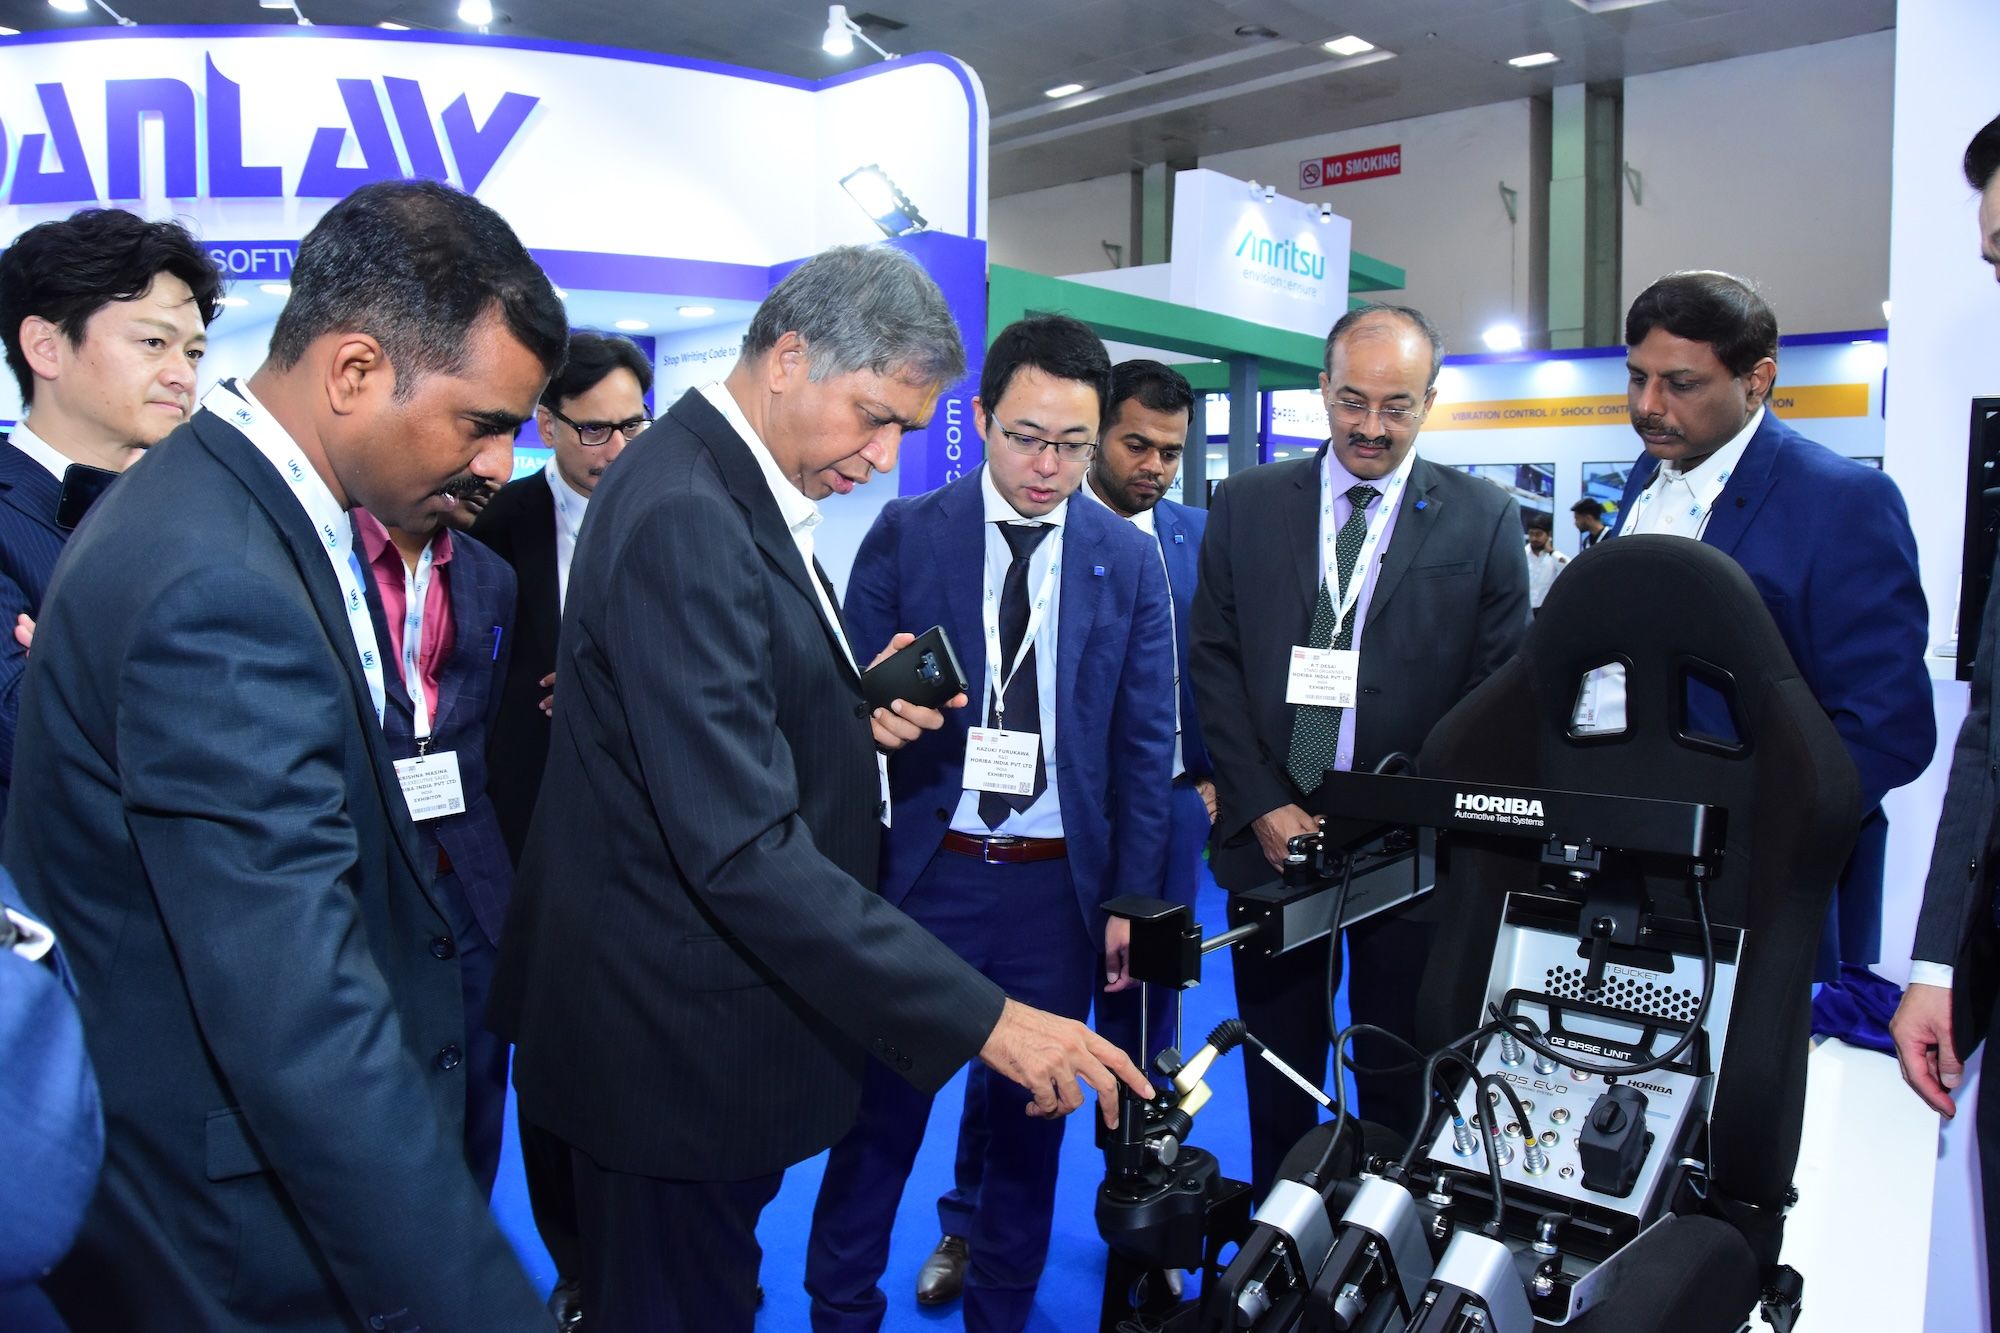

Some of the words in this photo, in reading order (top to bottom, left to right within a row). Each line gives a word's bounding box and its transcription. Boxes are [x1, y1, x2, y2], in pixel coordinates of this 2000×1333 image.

[1326, 162, 1343, 178] NO
[1346, 152, 1399, 175] SMOKING
[1235, 229, 1325, 280] Anritsu
[663, 355, 680, 366] Stop
[681, 350, 707, 364] Writing
[708, 347, 727, 359] Code
[1451, 410, 1500, 421] VIBRATION
[1503, 408, 1547, 418] CONTROL
[1560, 406, 1594, 417] SHOCK
[998, 748, 1030, 756] FURUKAWA
[425, 768, 448, 776] MASINA
[987, 771, 1015, 779] EXHIBITOR
[413, 794, 442, 803] EXHIBITOR
[1455, 792, 1544, 817] HORIBA
[1454, 810, 1495, 822] Automotive
[1495, 814, 1511, 823] Test
[1512, 815, 1544, 827] Systems
[1613, 966, 1660, 981] BUCKET
[1567, 1040, 1601, 1054] BASE
[1603, 1047, 1632, 1061] UNIT
[1533, 1080, 1568, 1094] EVO
[1627, 1079, 1673, 1096] HORIBA
